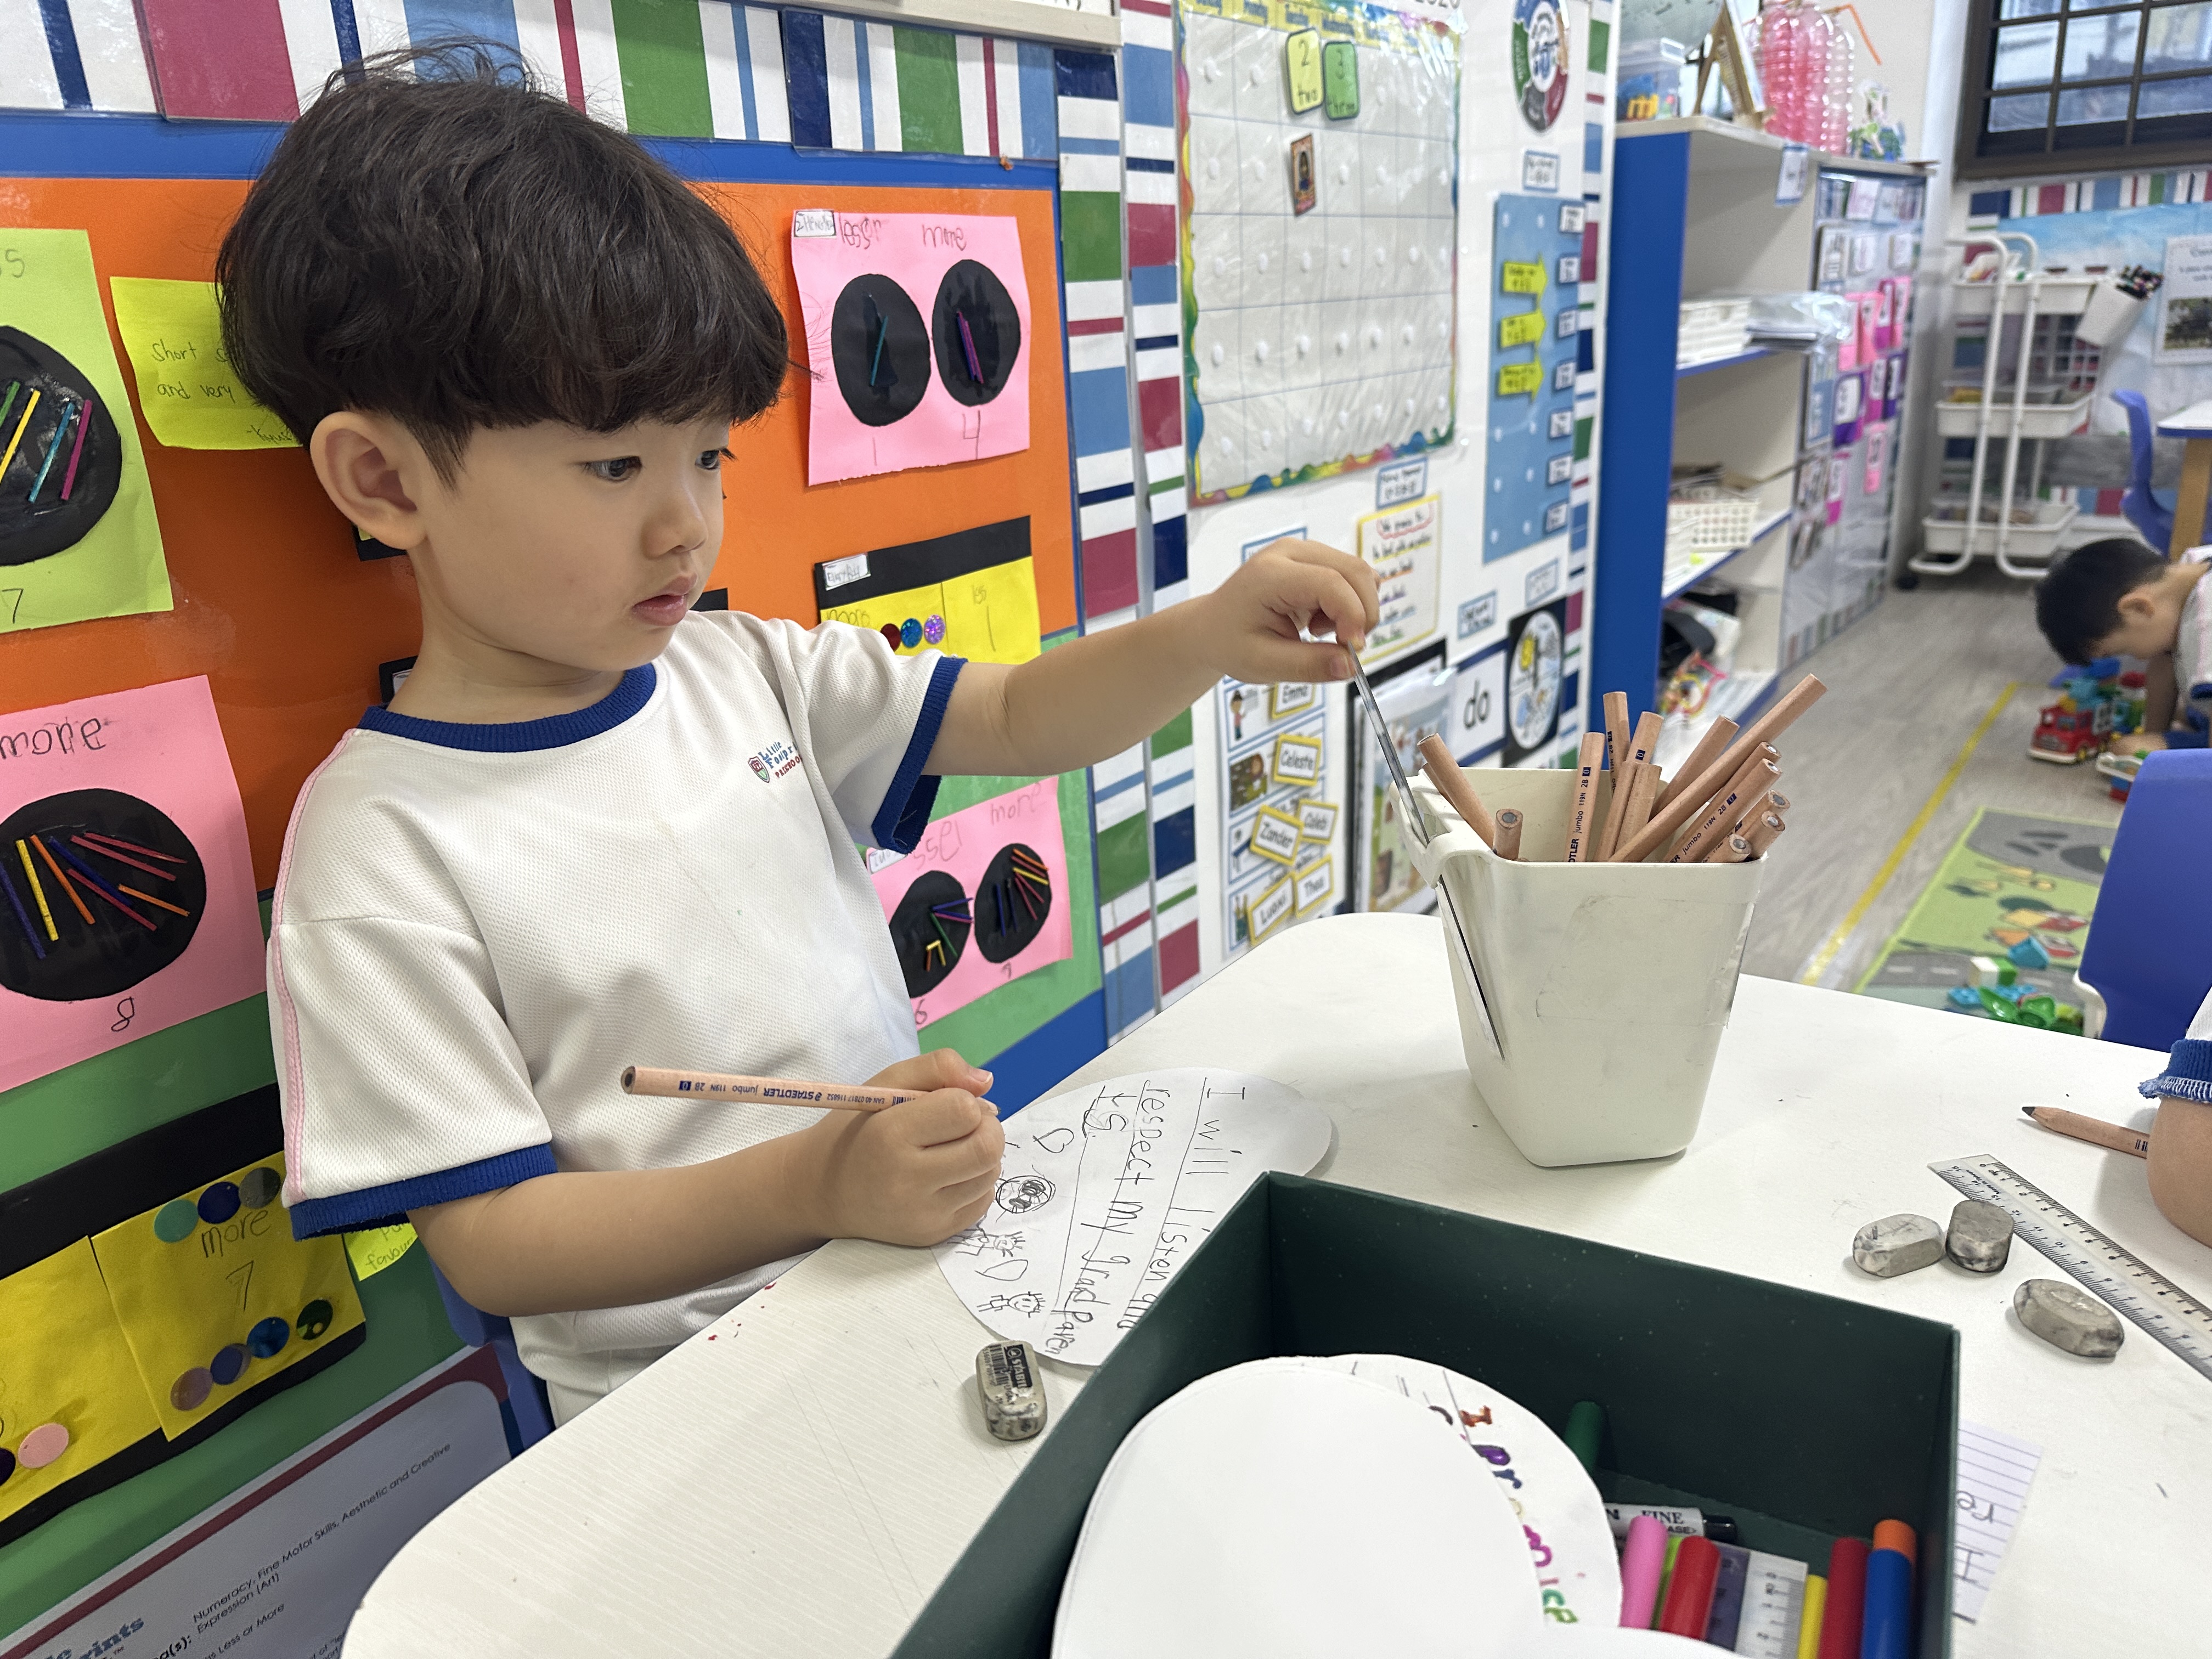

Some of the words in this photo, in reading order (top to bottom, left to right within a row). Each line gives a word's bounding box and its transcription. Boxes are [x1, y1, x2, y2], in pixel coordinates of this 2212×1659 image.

[1298, 38, 1311, 67] 2
[1335, 48, 1345, 80] 3
[1297, 82, 1318, 106] two
[151, 338, 196, 362] Short
[157, 381, 191, 399] and
[200, 384, 235, 404] very
[961, 410, 981, 460] 4
[1, 588, 24, 624] 7
[1463, 678, 1492, 730] do
[991, 782, 1047, 826] more
[1573, 810, 1584, 833] jumbo
[1581, 779, 1589, 788] 2B
[1682, 832, 1701, 855] jumbo
[1703, 816, 1717, 830] 119N
[1718, 804, 1726, 815] 2B
[915, 1001, 928, 1025] 6
[695, 1082, 706, 1091] 2B
[710, 1084, 727, 1093] 119N
[732, 1084, 759, 1097] jumbo
[763, 1087, 815, 1100] STAEDTLER
[1207, 1086, 1245, 1100] I
[1114, 1087, 1170, 1186] respect
[1186, 1119, 1243, 1175] will
[201, 1210, 272, 1259] more
[1080, 1200, 1144, 1235] my
[1146, 1207, 1216, 1282] listen
[225, 1260, 255, 1312] 7
[1459, 1404, 1492, 1427] I
[192, 1578, 256, 1624] Numeracy,
[257, 1560, 280, 1581] Fine
[282, 1535, 314, 1565] Motor
[315, 1521, 340, 1542] Skills,
[341, 1486, 389, 1523] Aesthetic
[390, 1470, 409, 1491] and
[410, 1443, 452, 1475] Creative
[196, 1590, 255, 1634] Expression
[256, 1572, 280, 1596] (Art)
[218, 1634, 241, 1654] Less
[242, 1626, 255, 1638] or
[256, 1603, 285, 1627] More
